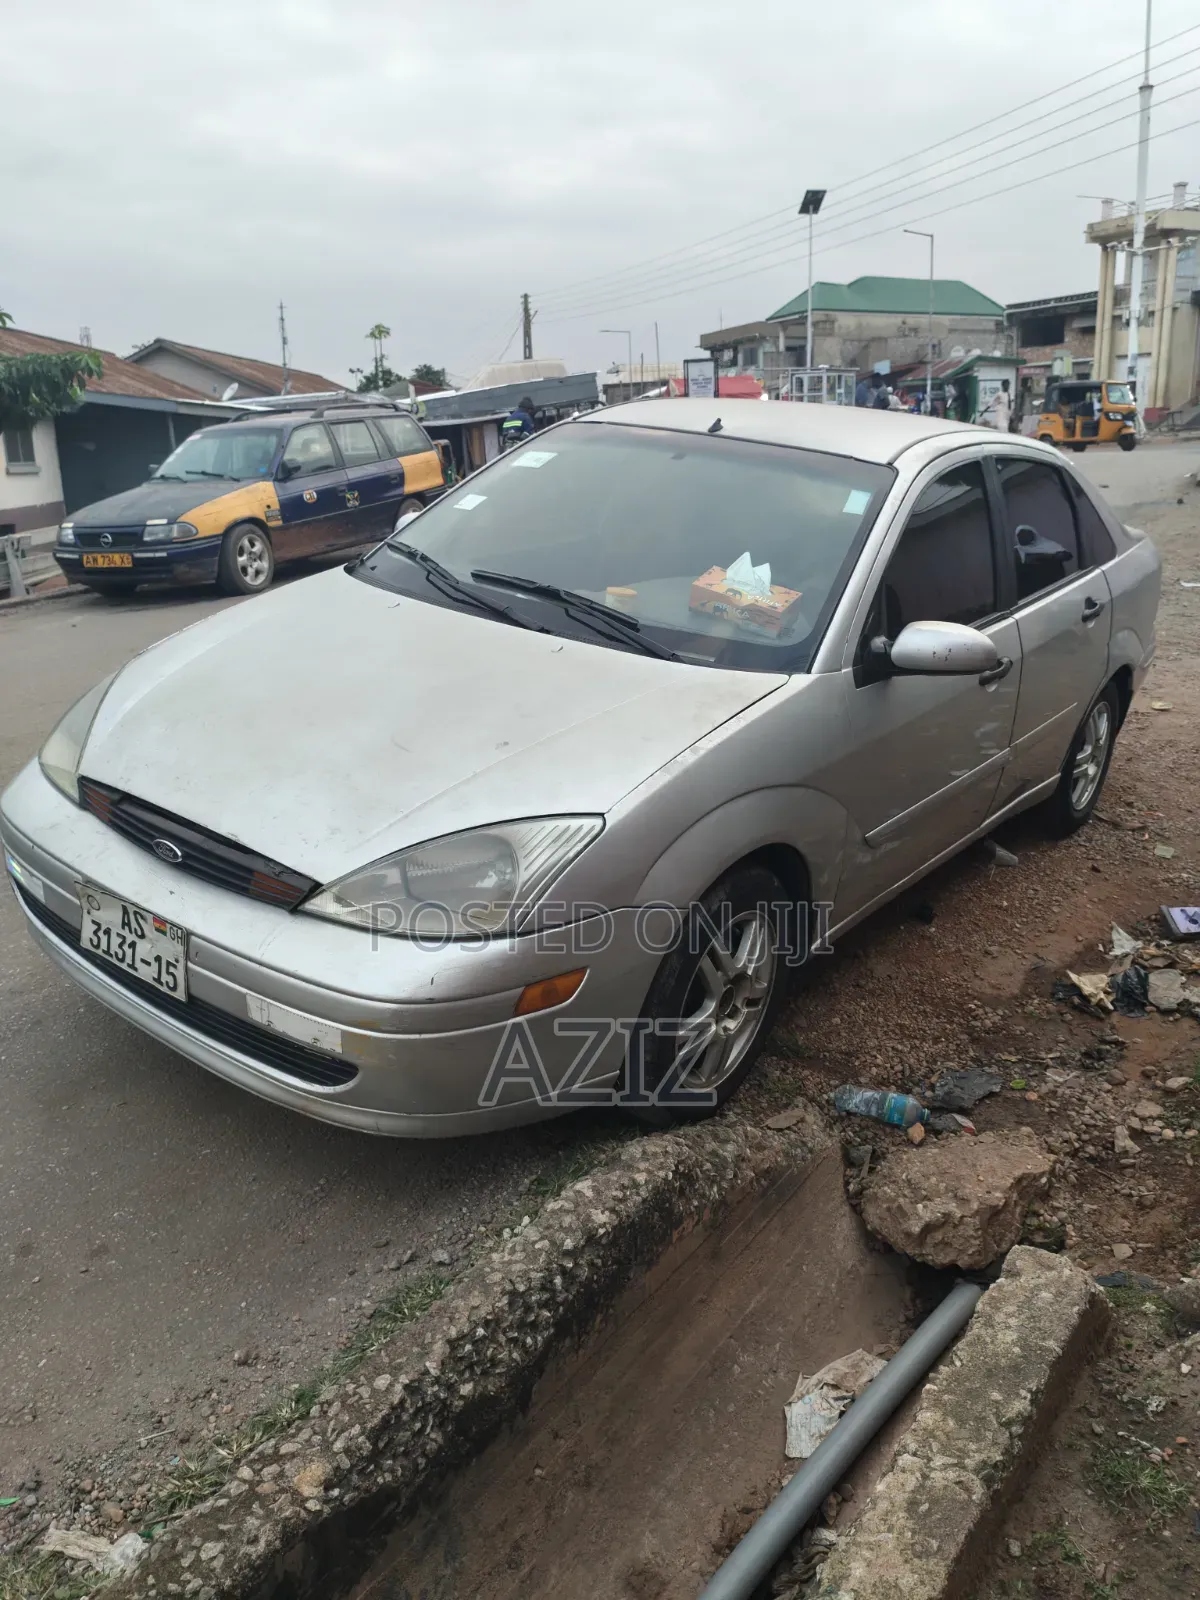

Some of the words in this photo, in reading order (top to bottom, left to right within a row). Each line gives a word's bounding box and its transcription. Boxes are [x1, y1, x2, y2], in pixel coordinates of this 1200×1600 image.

[121, 904, 146, 940] AS
[169, 926, 184, 947] GH
[89, 918, 179, 992] 3131-15
